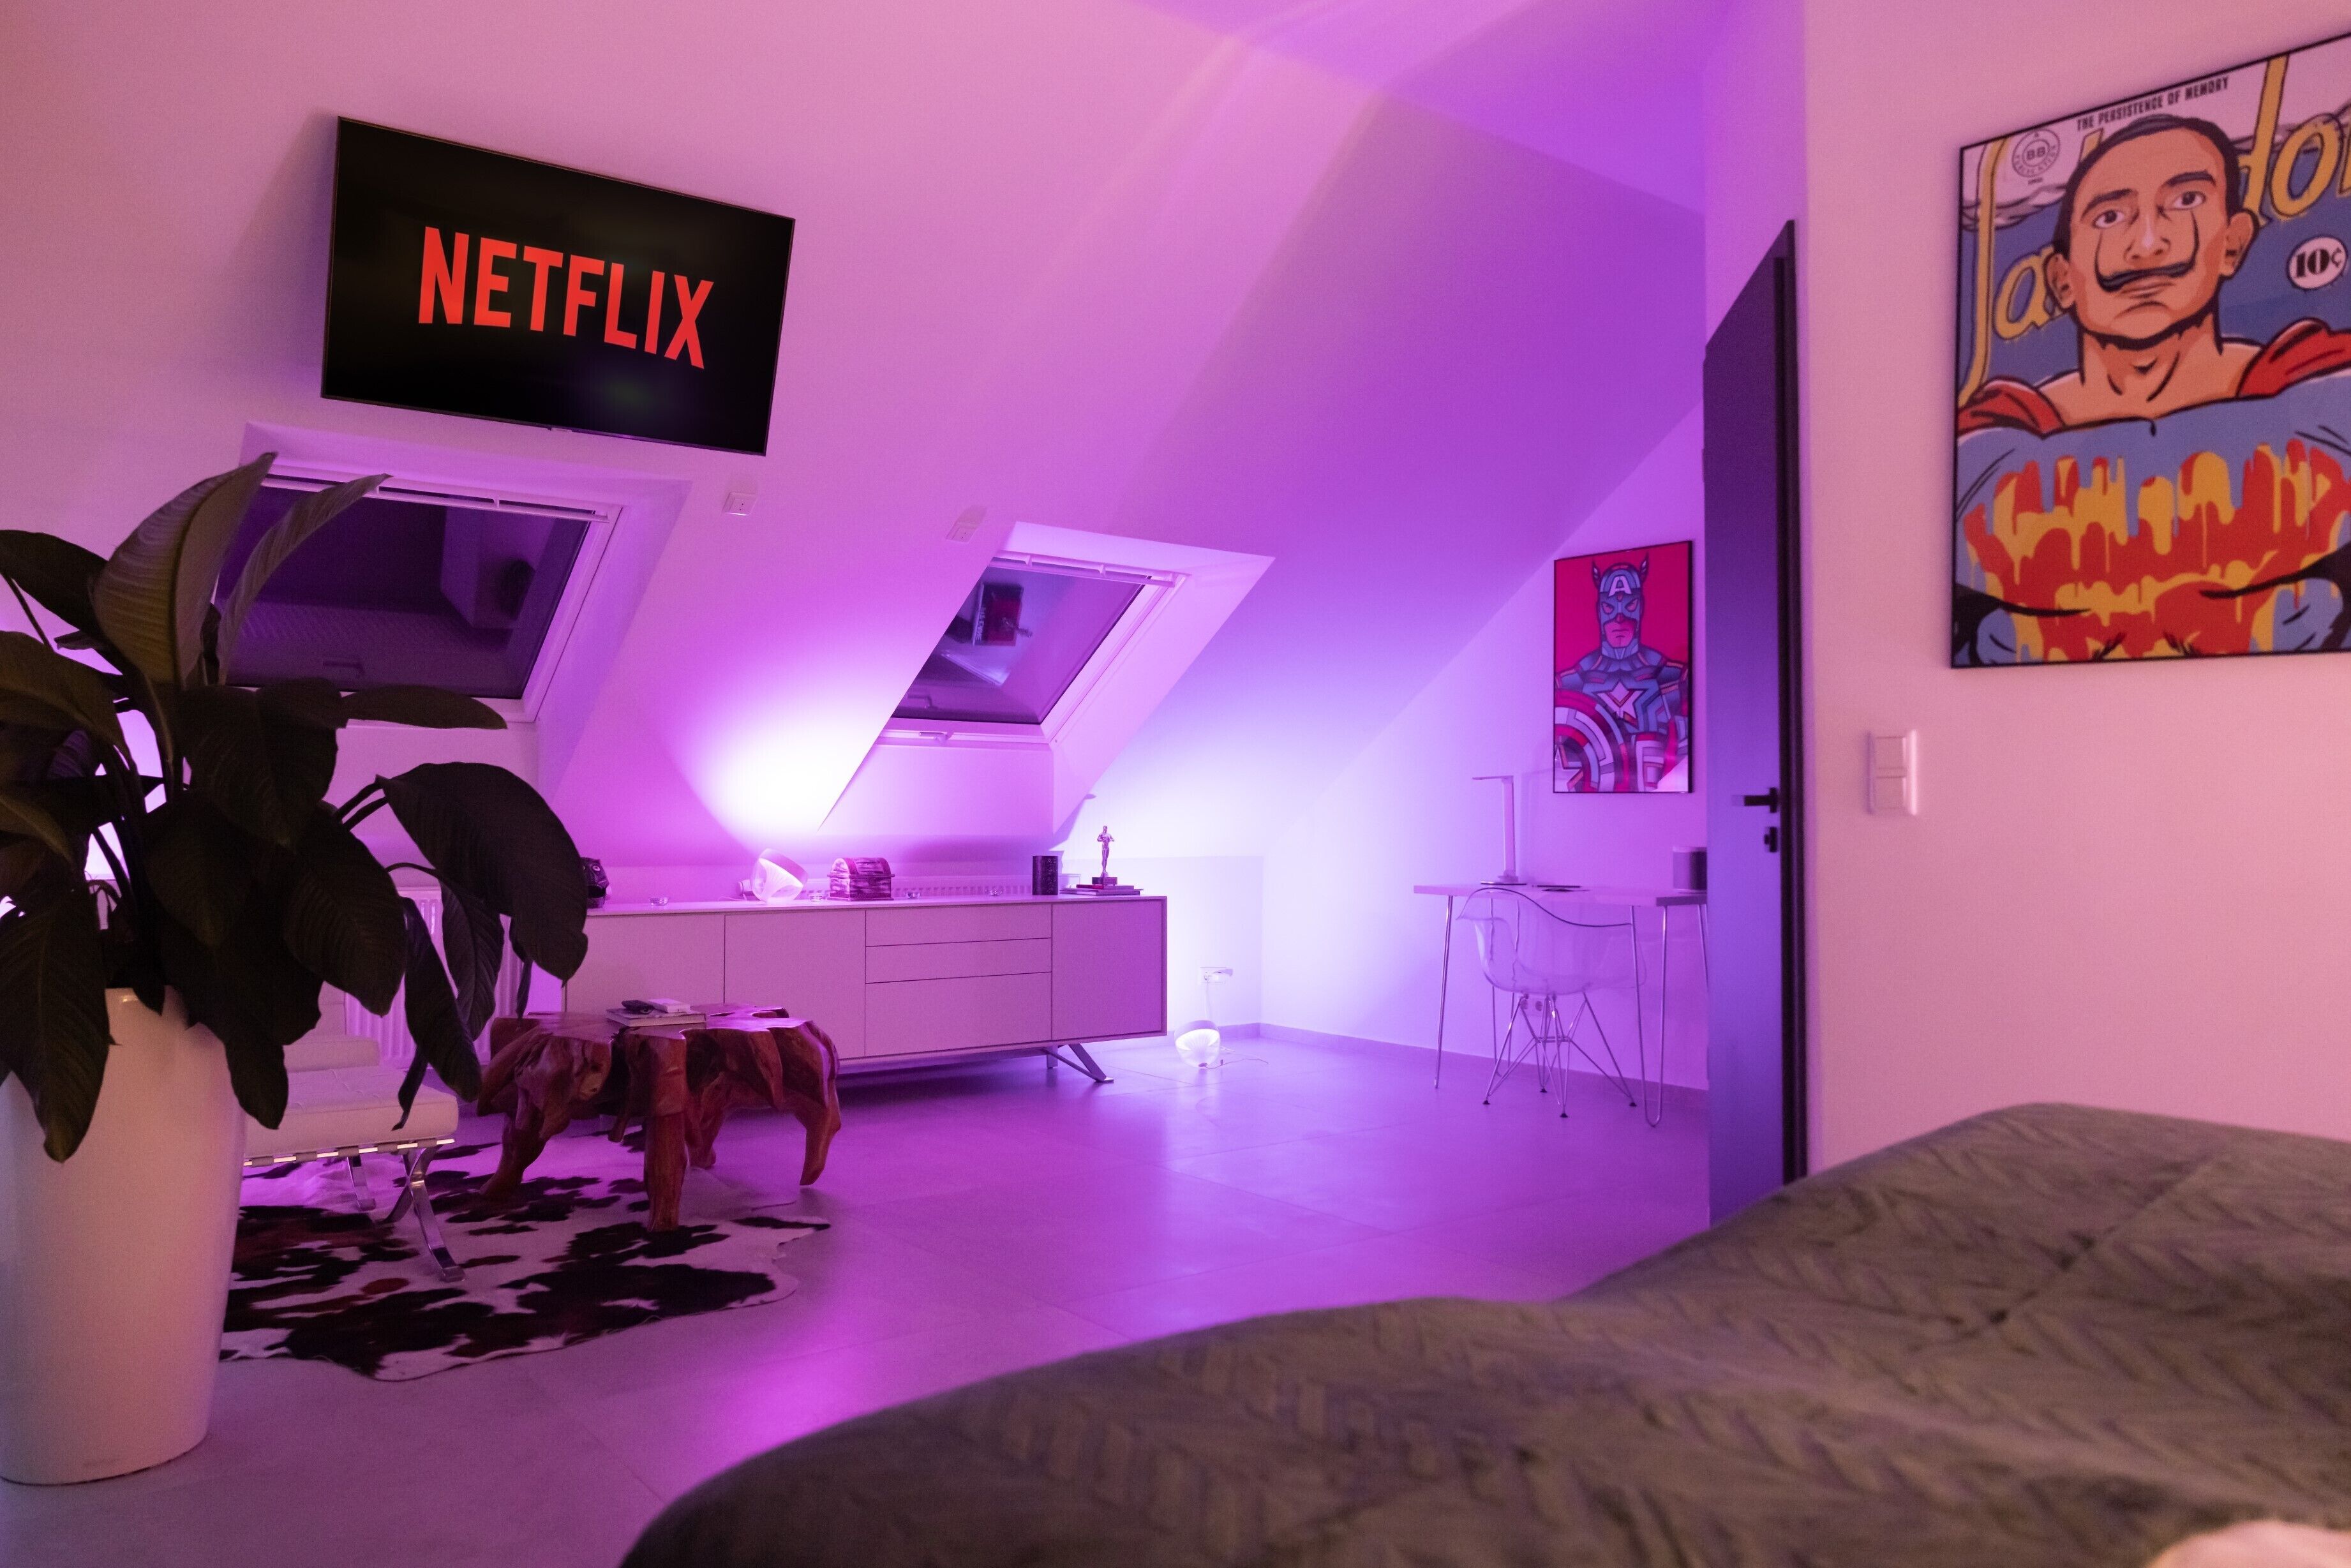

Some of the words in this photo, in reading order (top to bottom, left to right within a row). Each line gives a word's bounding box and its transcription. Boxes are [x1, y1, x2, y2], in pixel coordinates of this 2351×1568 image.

[2077, 115, 2094, 131] THE
[2098, 96, 2163, 125] PERSISTENCE
[2167, 89, 2181, 106] OF
[2184, 75, 2229, 101] MEMORY
[419, 226, 714, 370] NETFLIX
[1608, 576, 1632, 597] A
